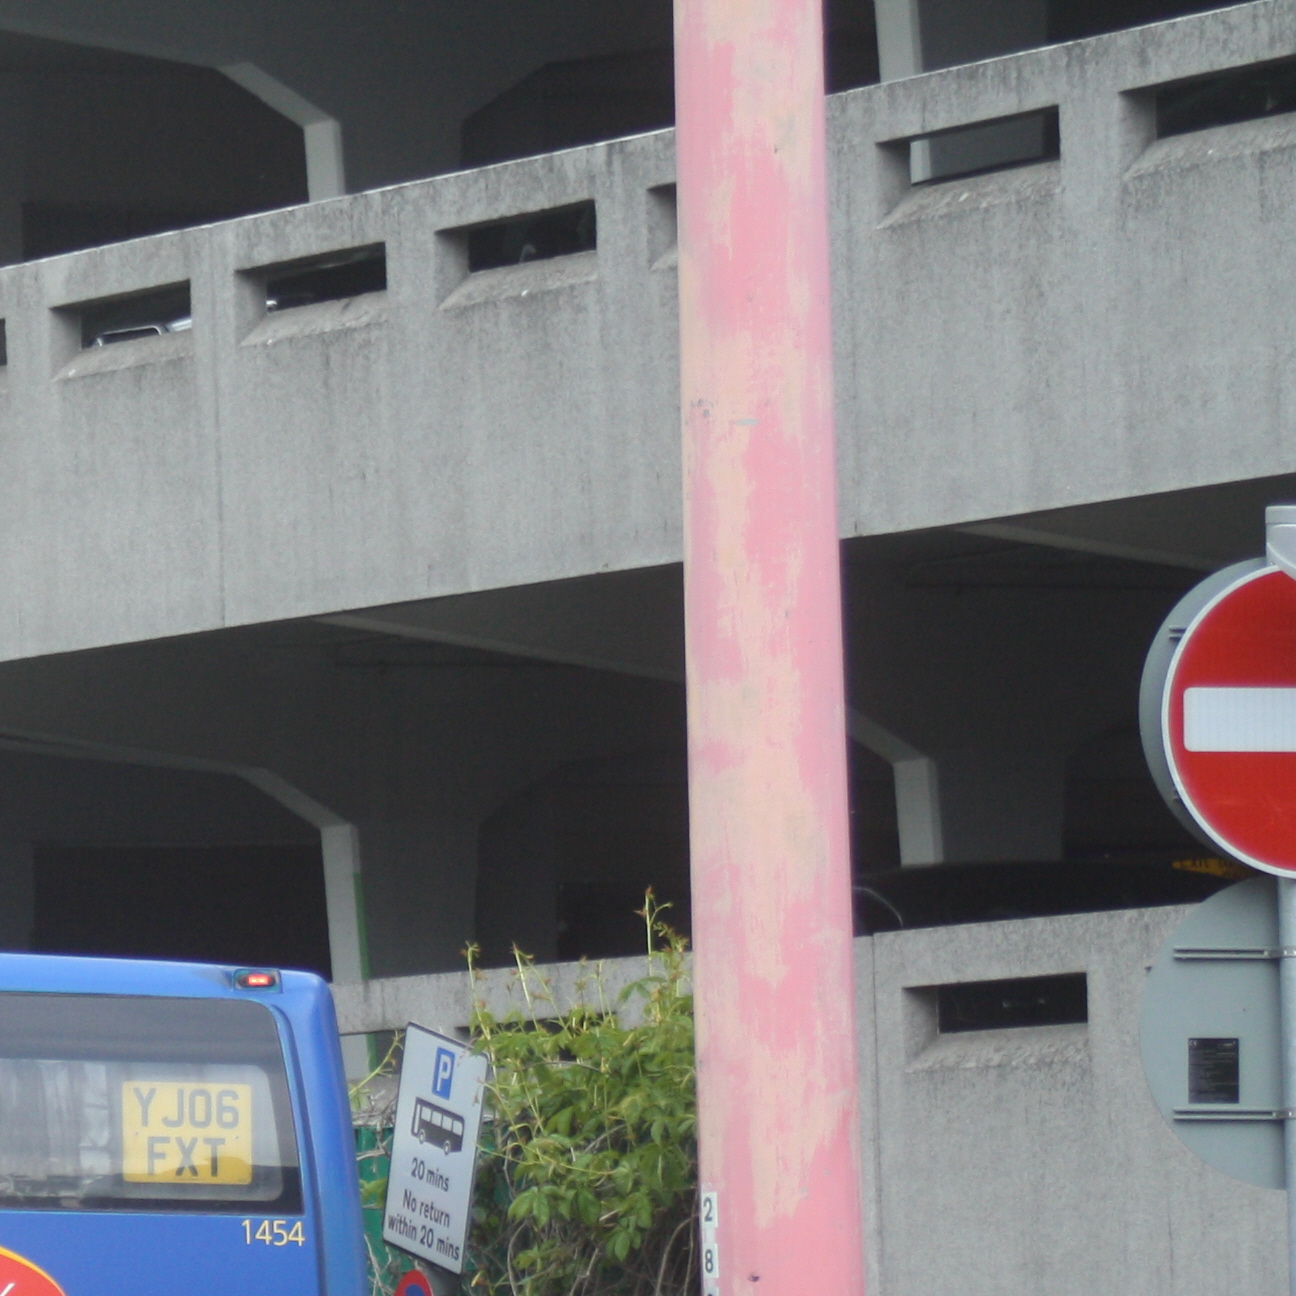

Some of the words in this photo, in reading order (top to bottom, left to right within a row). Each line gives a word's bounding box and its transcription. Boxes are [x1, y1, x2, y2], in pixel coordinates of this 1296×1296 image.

[133, 1087, 240, 1129] YJ06
[146, 1136, 227, 1178] FXT
[411, 1157, 425, 1180] 20
[426, 1168, 450, 1193] mins
[403, 1188, 417, 1213] No
[418, 1199, 451, 1228] return
[241, 1219, 306, 1246] 1454
[387, 1213, 418, 1243] within
[419, 1224, 434, 1249] 20
[435, 1236, 460, 1261] mins
